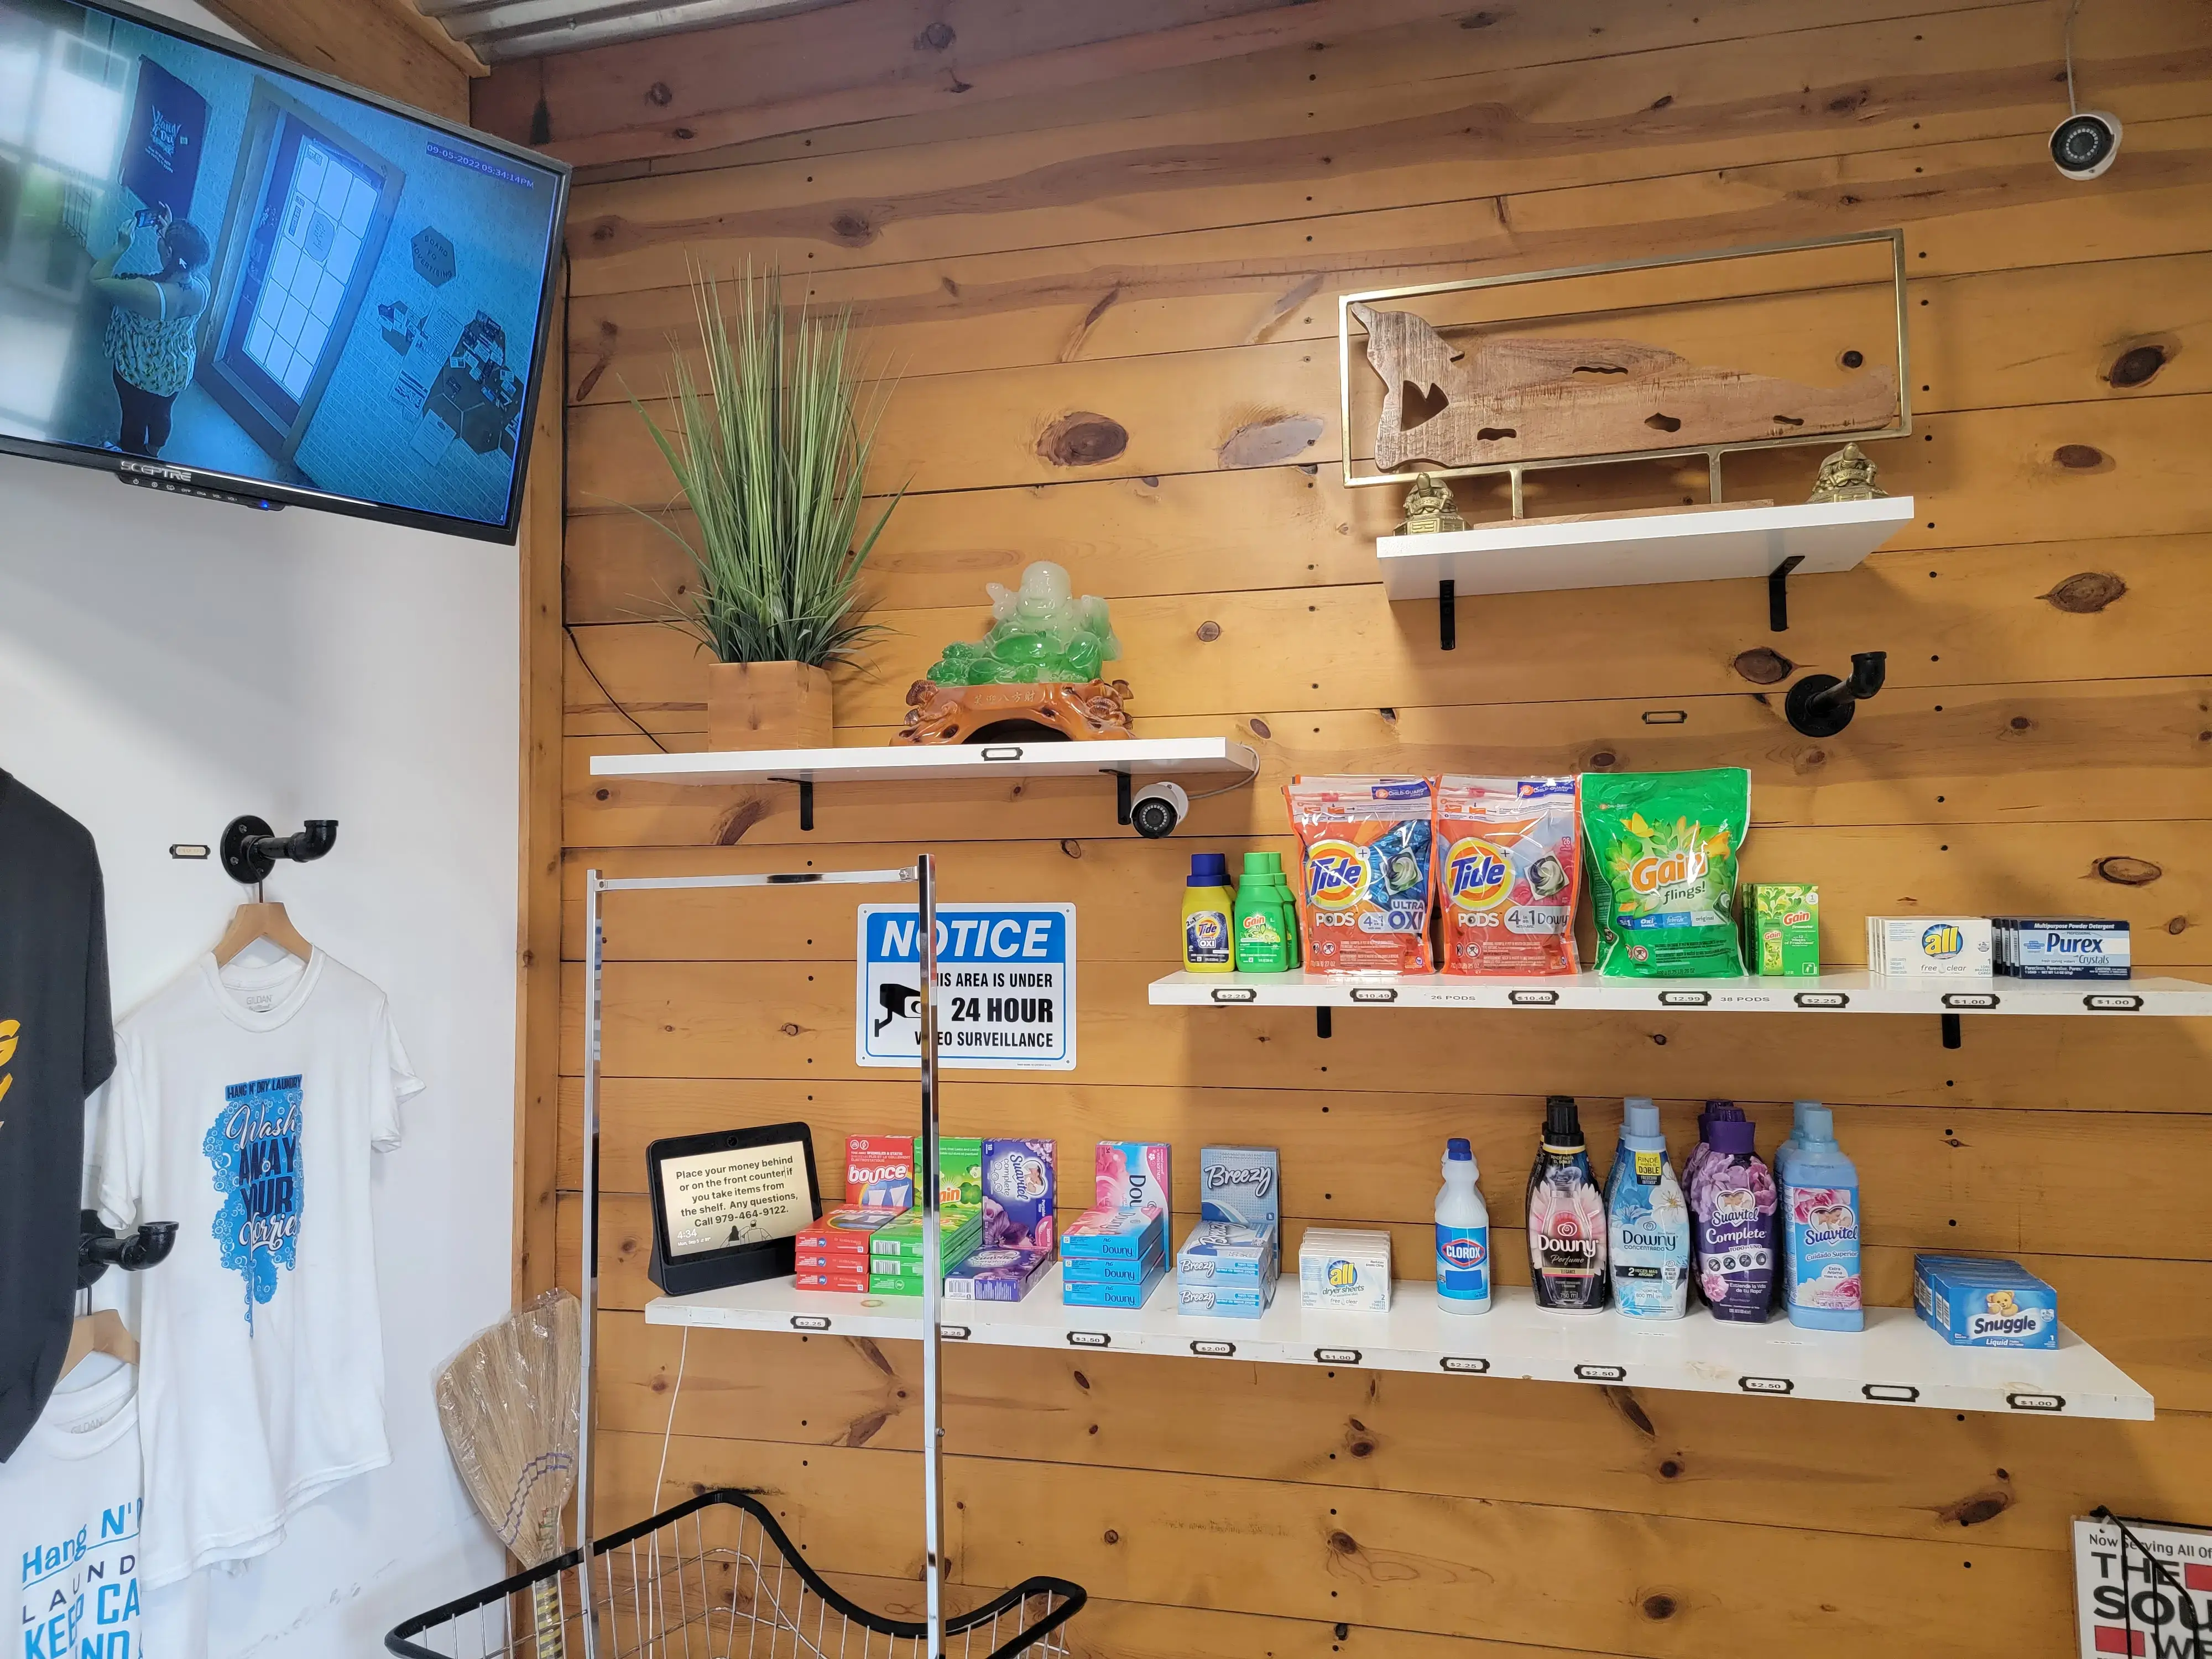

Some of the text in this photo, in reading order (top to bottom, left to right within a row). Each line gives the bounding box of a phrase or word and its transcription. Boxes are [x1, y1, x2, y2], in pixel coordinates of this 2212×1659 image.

[427, 144, 534, 190] 09-05-2022 05:34:14PM
[121, 461, 192, 482] SCEPTRE
[1310, 858, 1361, 896] Tide
[1451, 855, 1505, 897] Tide
[1632, 852, 1706, 892] Gain
[1663, 881, 1705, 905] flings!
[1393, 901, 1424, 910] ULTRA
[1244, 916, 1265, 928] Gain
[1316, 912, 1355, 927] PODS
[1363, 916, 1373, 926] 4
[1389, 911, 1423, 930] OXI
[1458, 912, 1499, 927] PODS
[1507, 910, 1535, 925] 4 1
[1783, 912, 1810, 925] Gain
[1199, 924, 1217, 936] Tide
[1925, 926, 1959, 955] all
[2047, 933, 2103, 953] Purex
[2079, 954, 2109, 964] Crystals
[956, 973, 1052, 988] AREA IS UNDER
[247, 995, 272, 1005] GILDAN
[952, 998, 1053, 1023] 24 HOUR
[957, 1031, 1053, 1047] SURVEILLANCE
[227, 1086, 247, 1099] HANG
[257, 1081, 270, 1093] DRY
[272, 1077, 301, 1091] LAUNDRY
[226, 1104, 296, 1150] Wash
[239, 1136, 296, 1186] AWAY
[676, 1156, 793, 1180] Place your money behind
[706, 1178, 722, 1188] the
[724, 1175, 747, 1185] front
[749, 1170, 785, 1181] counter
[848, 1164, 907, 1185] bounce
[1002, 1159, 1012, 1196] complete
[1010, 1154, 1029, 1200] Suavitel
[1204, 1164, 1272, 1197] Breezy
[240, 1176, 294, 1224] YOUR
[692, 1182, 784, 1204] you take items from
[681, 1193, 798, 1217] the shelf. Any questions,
[695, 1205, 789, 1227] Call 979-464-9122.
[1713, 1208, 1758, 1225] Suavitel
[677, 1228, 697, 1239] 4:34
[1623, 1230, 1676, 1251] Downy
[1706, 1228, 1766, 1244] Complete
[1806, 1226, 1858, 1245] Suavitel
[1103, 1245, 1133, 1257] Downy
[1446, 1245, 1480, 1259] CLOROX
[1538, 1234, 1596, 1257] Downy
[1551, 1255, 1584, 1265] Perfume
[1807, 1253, 1831, 1261] Cuidado
[1105, 1269, 1135, 1281] Downy
[1180, 1260, 1215, 1278] Breezy
[1330, 1263, 1354, 1285] all
[1628, 1267, 1634, 1276] 2
[1105, 1293, 1135, 1306] Downy
[1180, 1291, 1215, 1309] Breezy
[1323, 1287, 1342, 1296] dryer
[1974, 1316, 2036, 1334] Snuggle
[22, 1524, 87, 1584] Hang
[2089, 1534, 2119, 1547] Now
[2178, 1545, 2194, 1557] All
[2091, 1551, 2180, 1587] THE
[25, 1593, 84, 1659] KEEP
